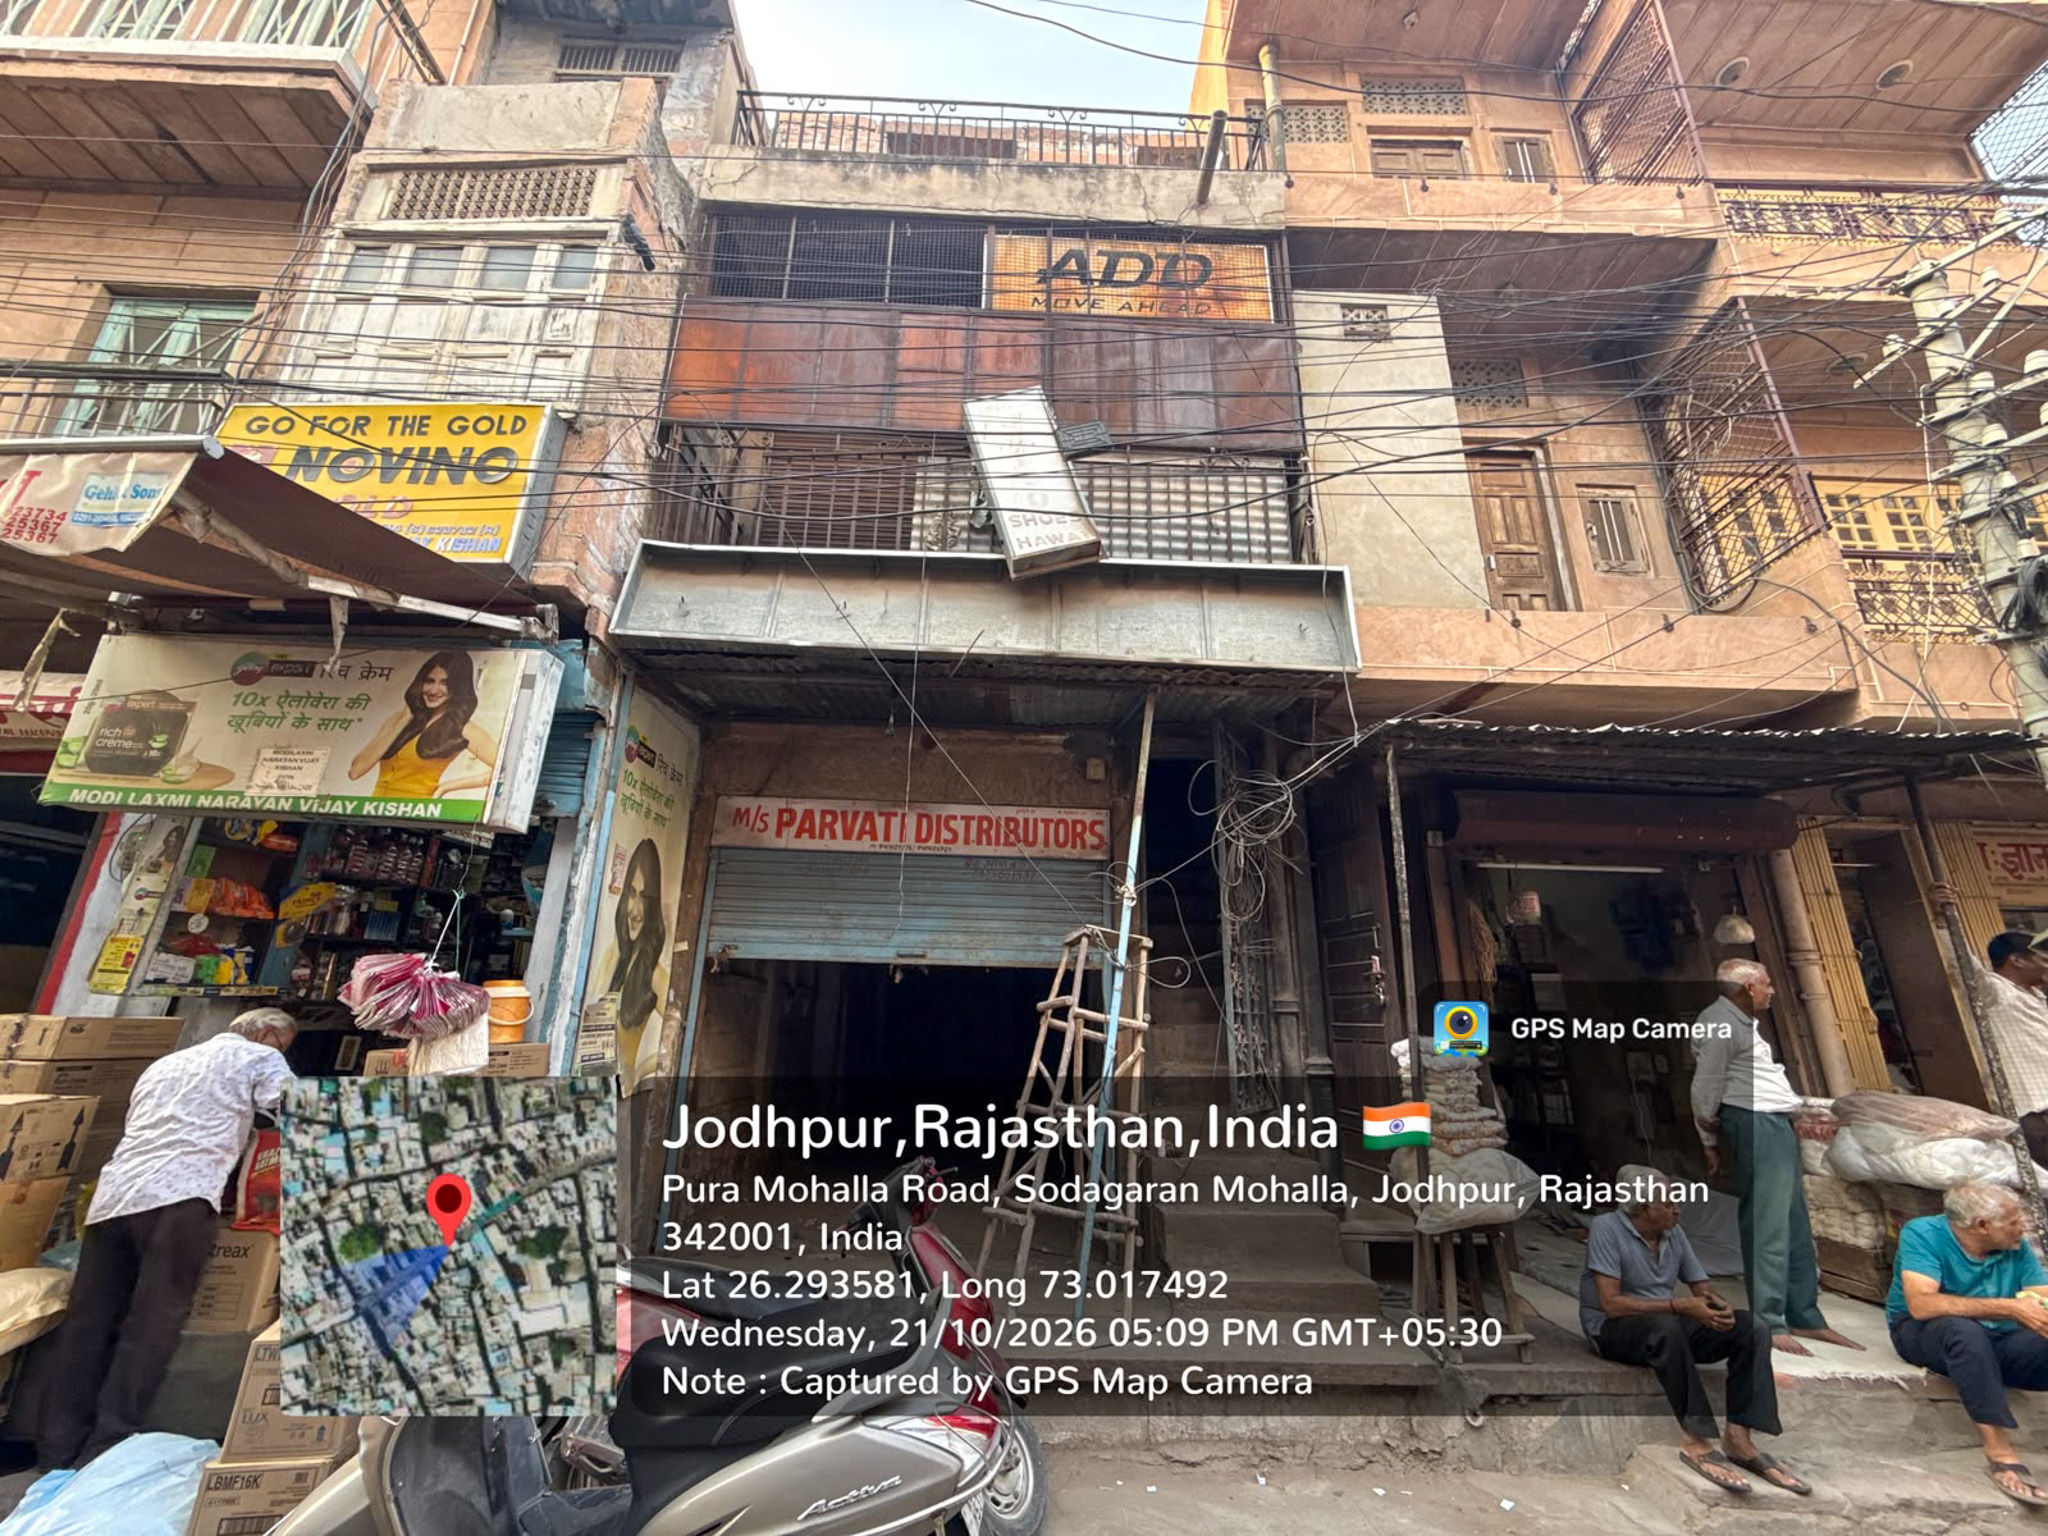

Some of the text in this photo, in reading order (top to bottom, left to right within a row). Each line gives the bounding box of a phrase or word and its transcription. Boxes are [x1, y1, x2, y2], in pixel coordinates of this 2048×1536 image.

[1036, 249, 1213, 290] ADD
[1031, 296, 1212, 316] MOVE AHEAD
[245, 415, 527, 436] GO FOR THE GOLD
[285, 445, 519, 485] NOVINO
[436, 537, 502, 553] KISHAN
[232, 691, 272, 708] 10x
[342, 692, 371, 712] की
[100, 726, 122, 738] rich
[292, 713, 312, 731] के
[69, 788, 442, 818] MODI LAXMI NARAYAN VIJAY KISHAN
[775, 808, 907, 843] PARVATI
[915, 812, 1107, 850] DISTRIBUTORS
[241, 1410, 269, 1424] LUX
[796, 1473, 903, 1520] Activa
